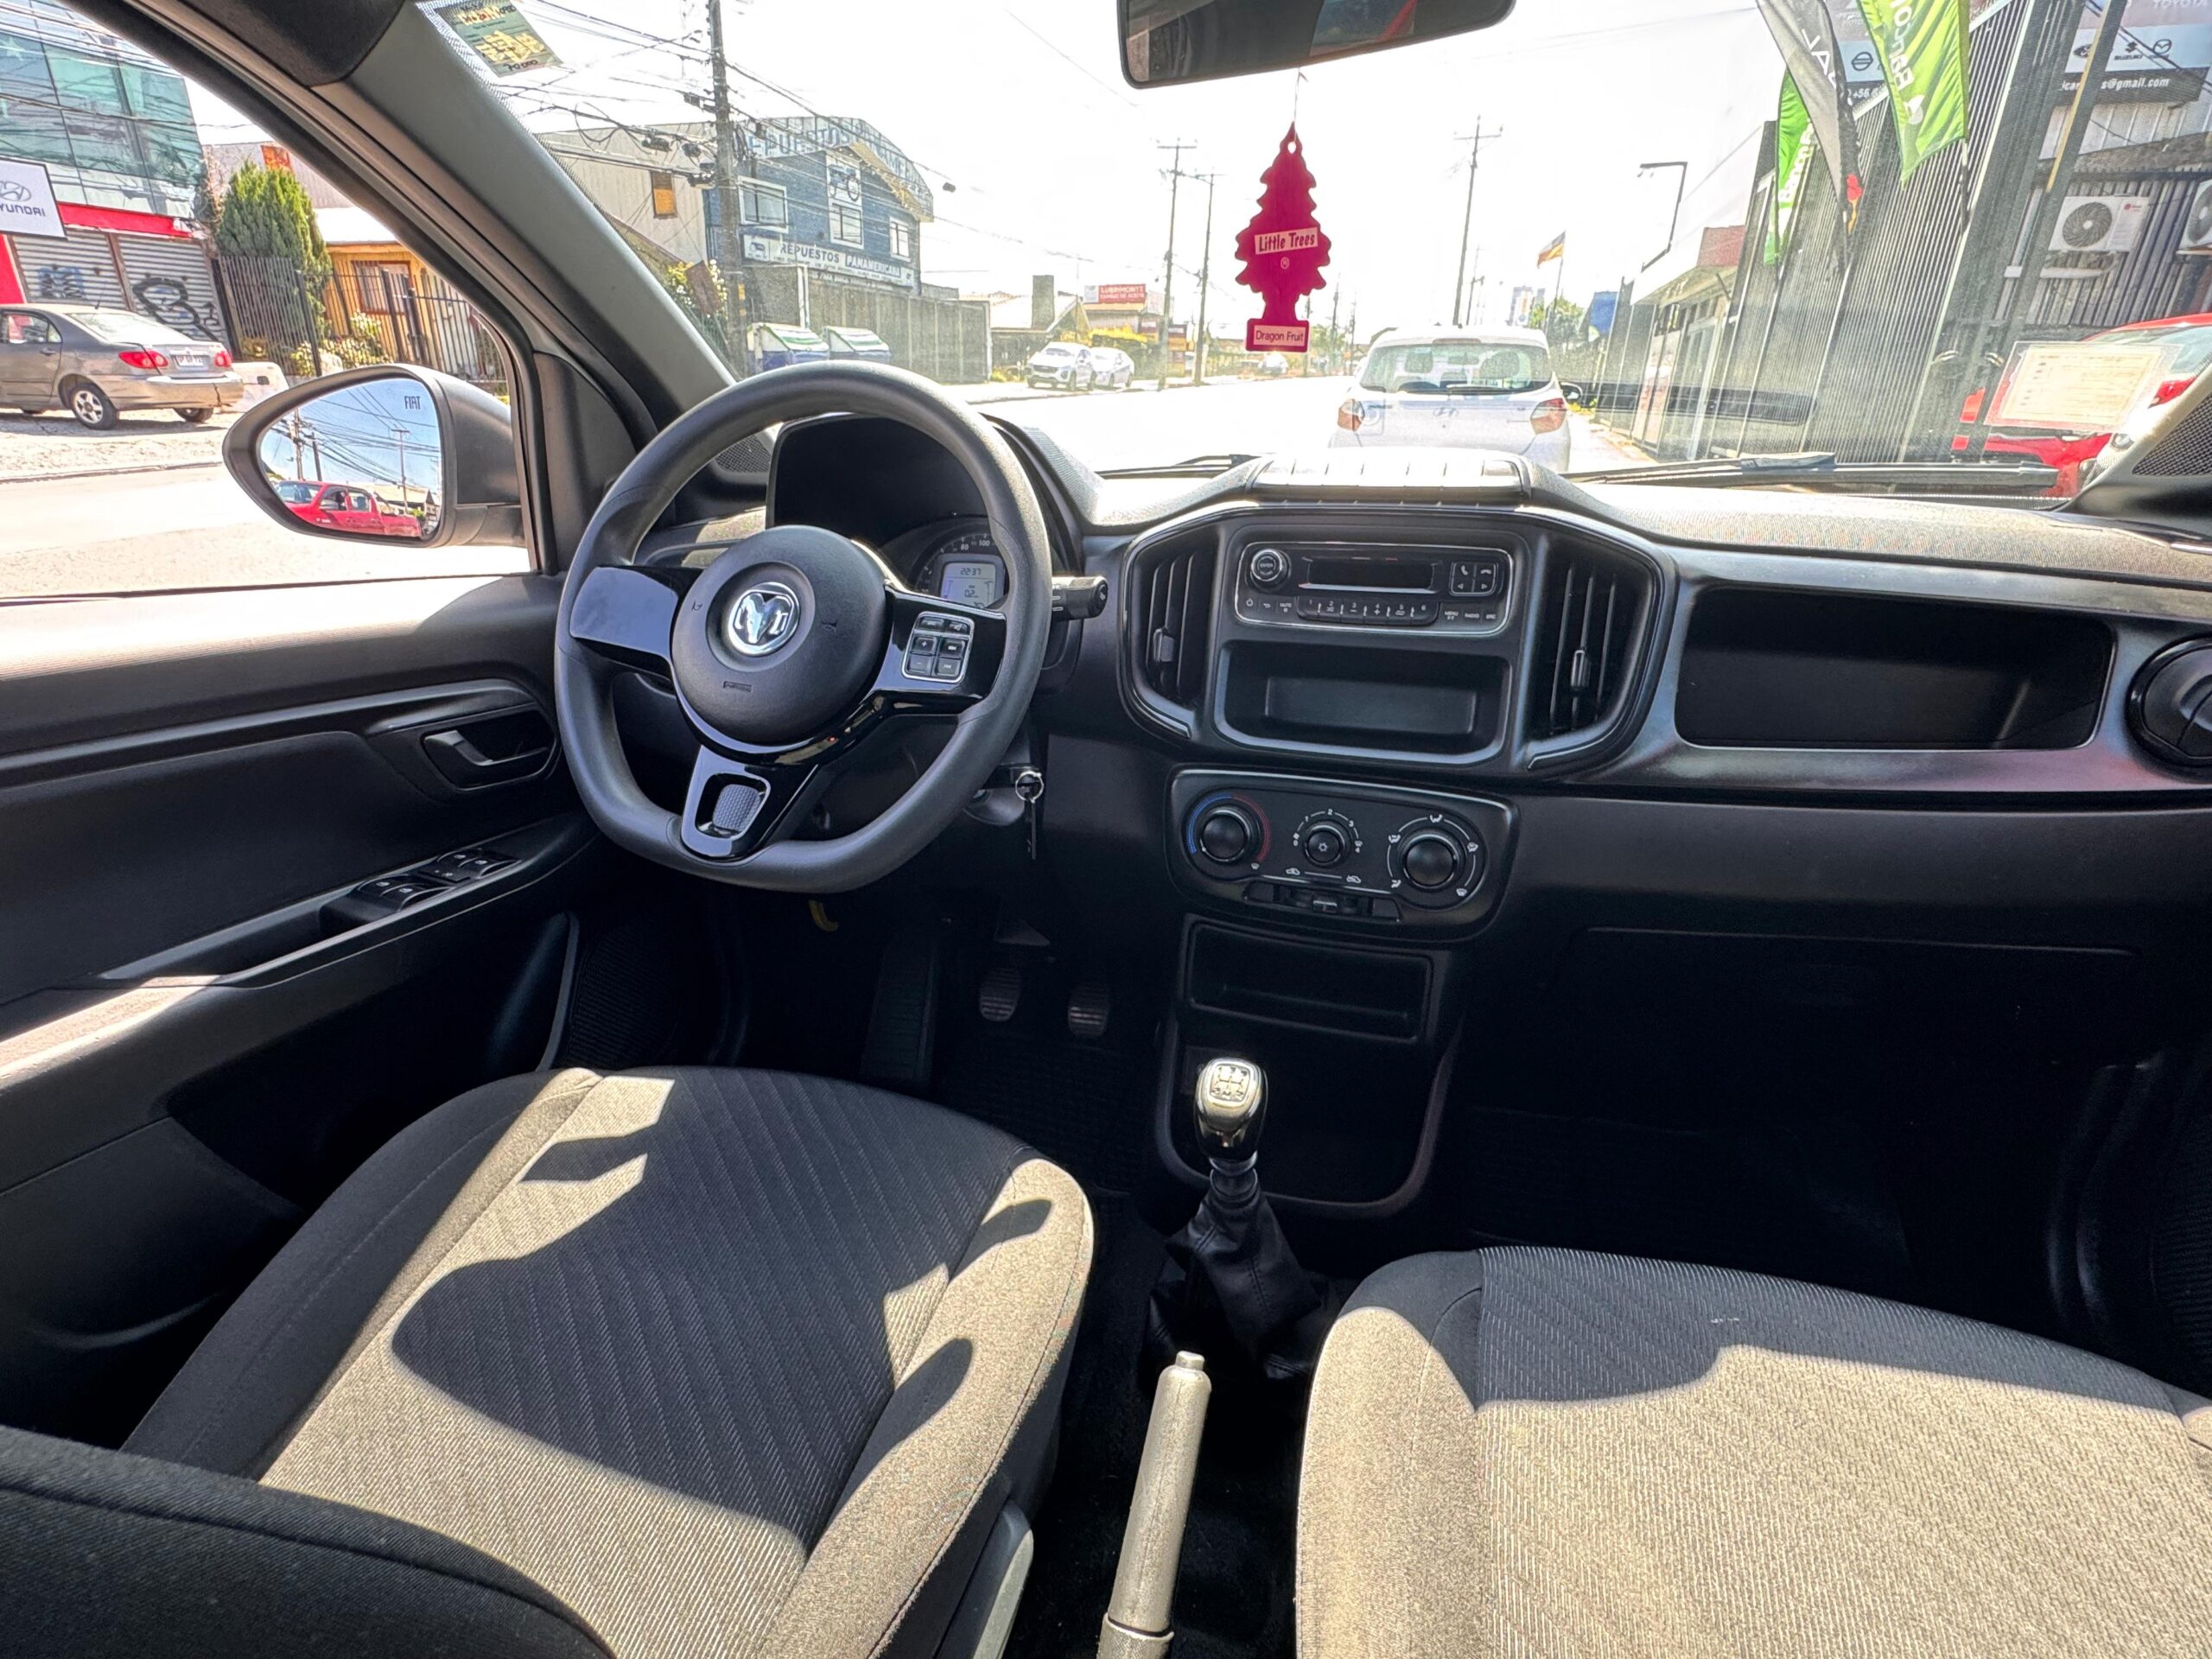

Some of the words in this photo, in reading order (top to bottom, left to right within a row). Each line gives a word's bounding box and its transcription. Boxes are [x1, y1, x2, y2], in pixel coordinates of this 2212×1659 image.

[1259, 234, 1286, 252] Little
[1288, 232, 1315, 248] Trees
[780, 242, 840, 264] REPUESTOS
[1255, 330, 1284, 343] Dragon
[1287, 332, 1304, 341] Fruit
[404, 396, 421, 410] FIAT
